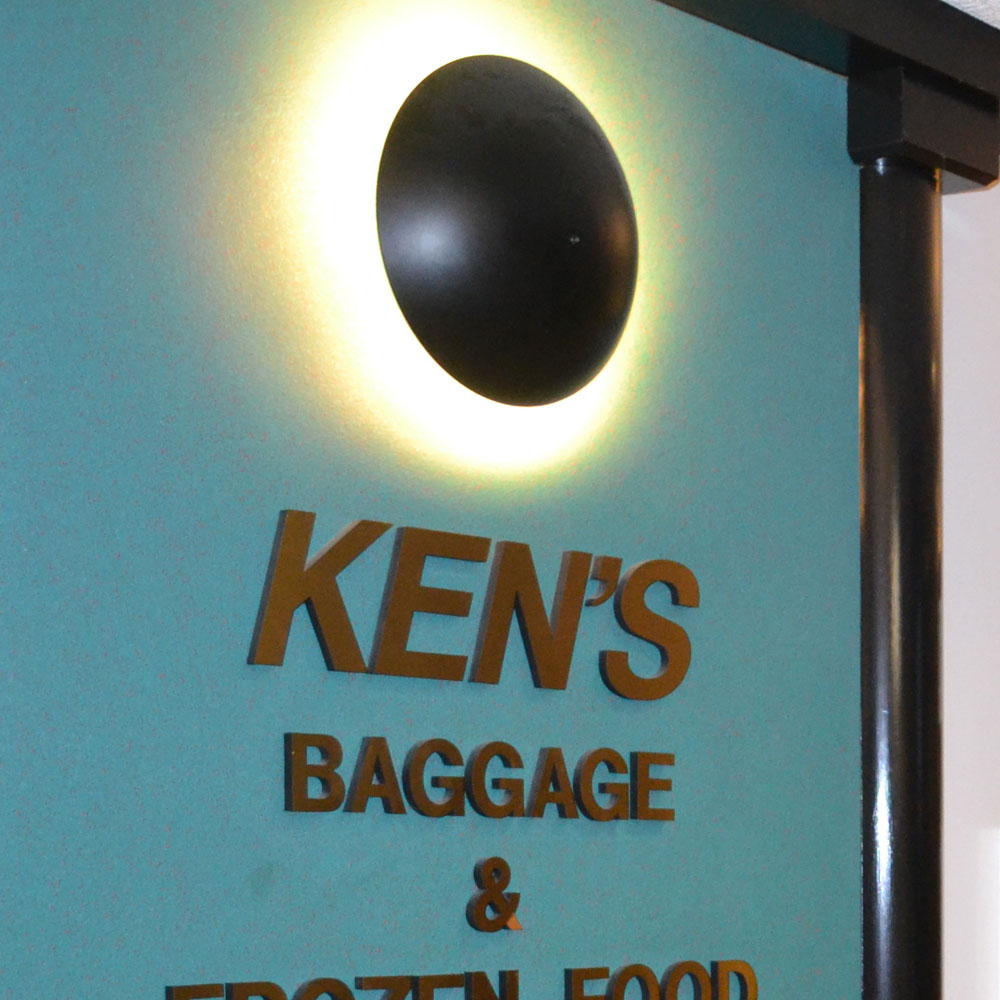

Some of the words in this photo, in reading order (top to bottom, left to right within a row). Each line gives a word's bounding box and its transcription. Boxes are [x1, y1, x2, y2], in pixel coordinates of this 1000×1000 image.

[247, 509, 700, 701] KEN'S
[284, 732, 676, 822] BAGGAGE
[465, 856, 523, 933] &
